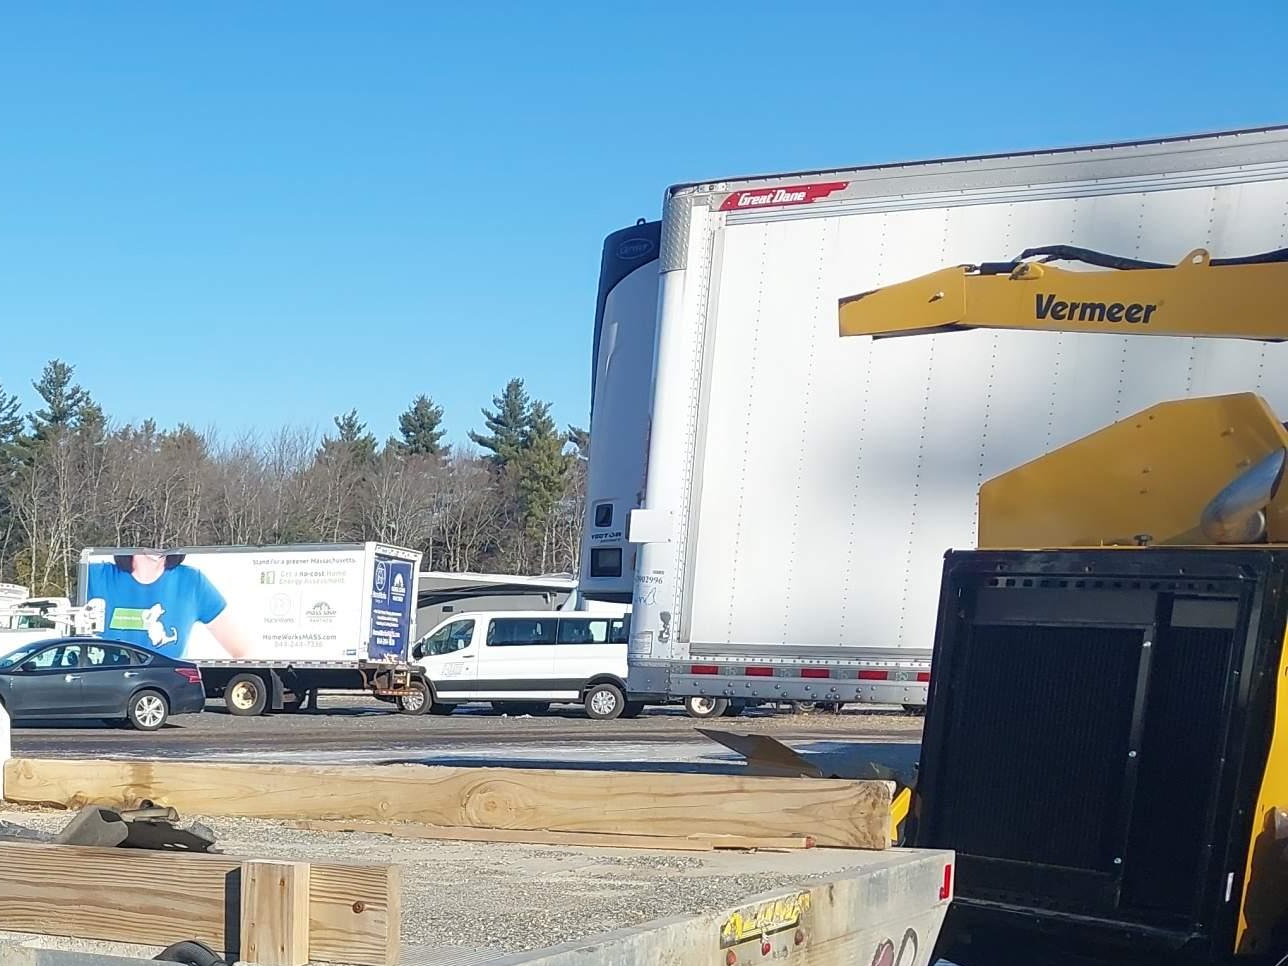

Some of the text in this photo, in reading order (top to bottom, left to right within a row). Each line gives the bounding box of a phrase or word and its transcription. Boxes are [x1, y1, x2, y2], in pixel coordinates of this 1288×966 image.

[737, 189, 807, 206] Great Dane
[1035, 293, 1157, 324] Vermeer
[252, 558, 270, 566] Stand
